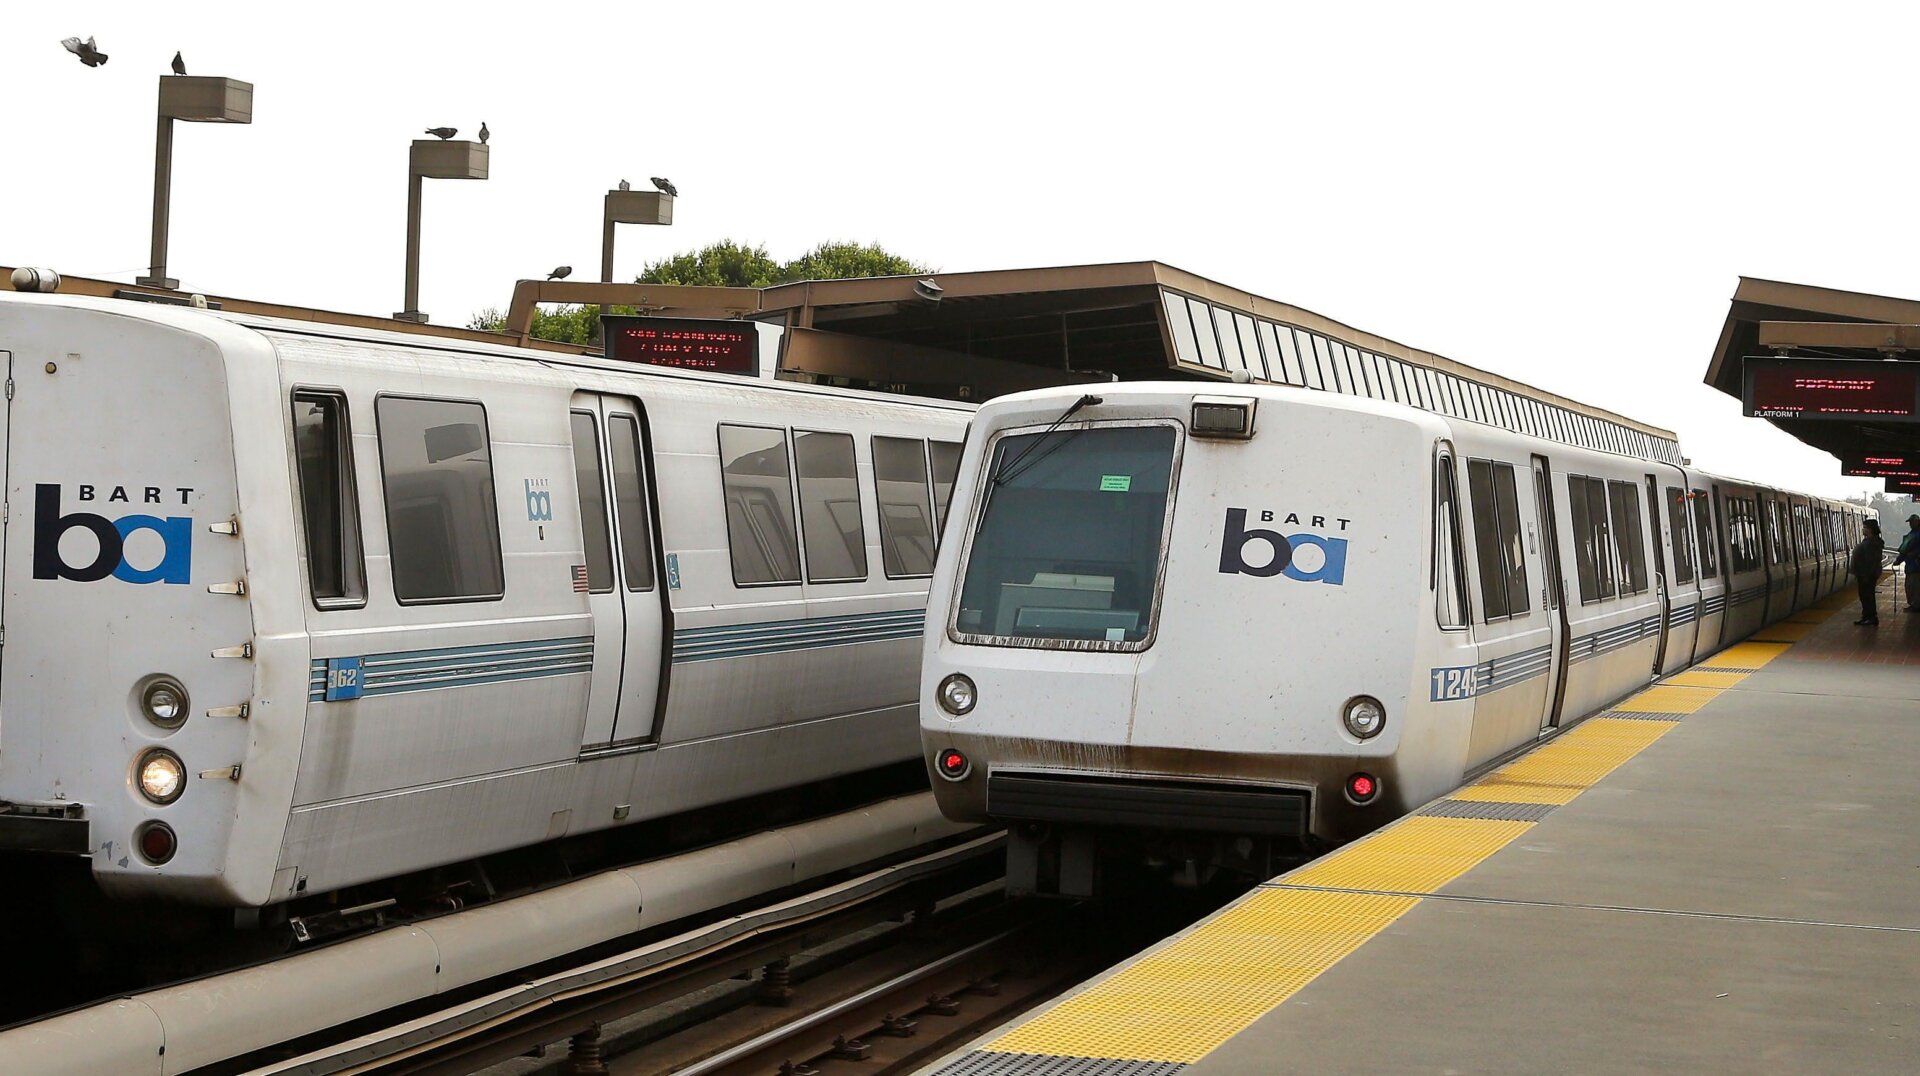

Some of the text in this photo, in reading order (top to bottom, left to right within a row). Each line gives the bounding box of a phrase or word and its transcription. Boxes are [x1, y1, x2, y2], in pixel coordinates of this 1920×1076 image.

[1754, 410, 1793, 418] PLATFORM
[530, 478, 548, 487] BART
[79, 484, 194, 504] BART
[1260, 510, 1351, 531] BART
[328, 668, 357, 689] 362
[1432, 667, 1478, 700] 1245
